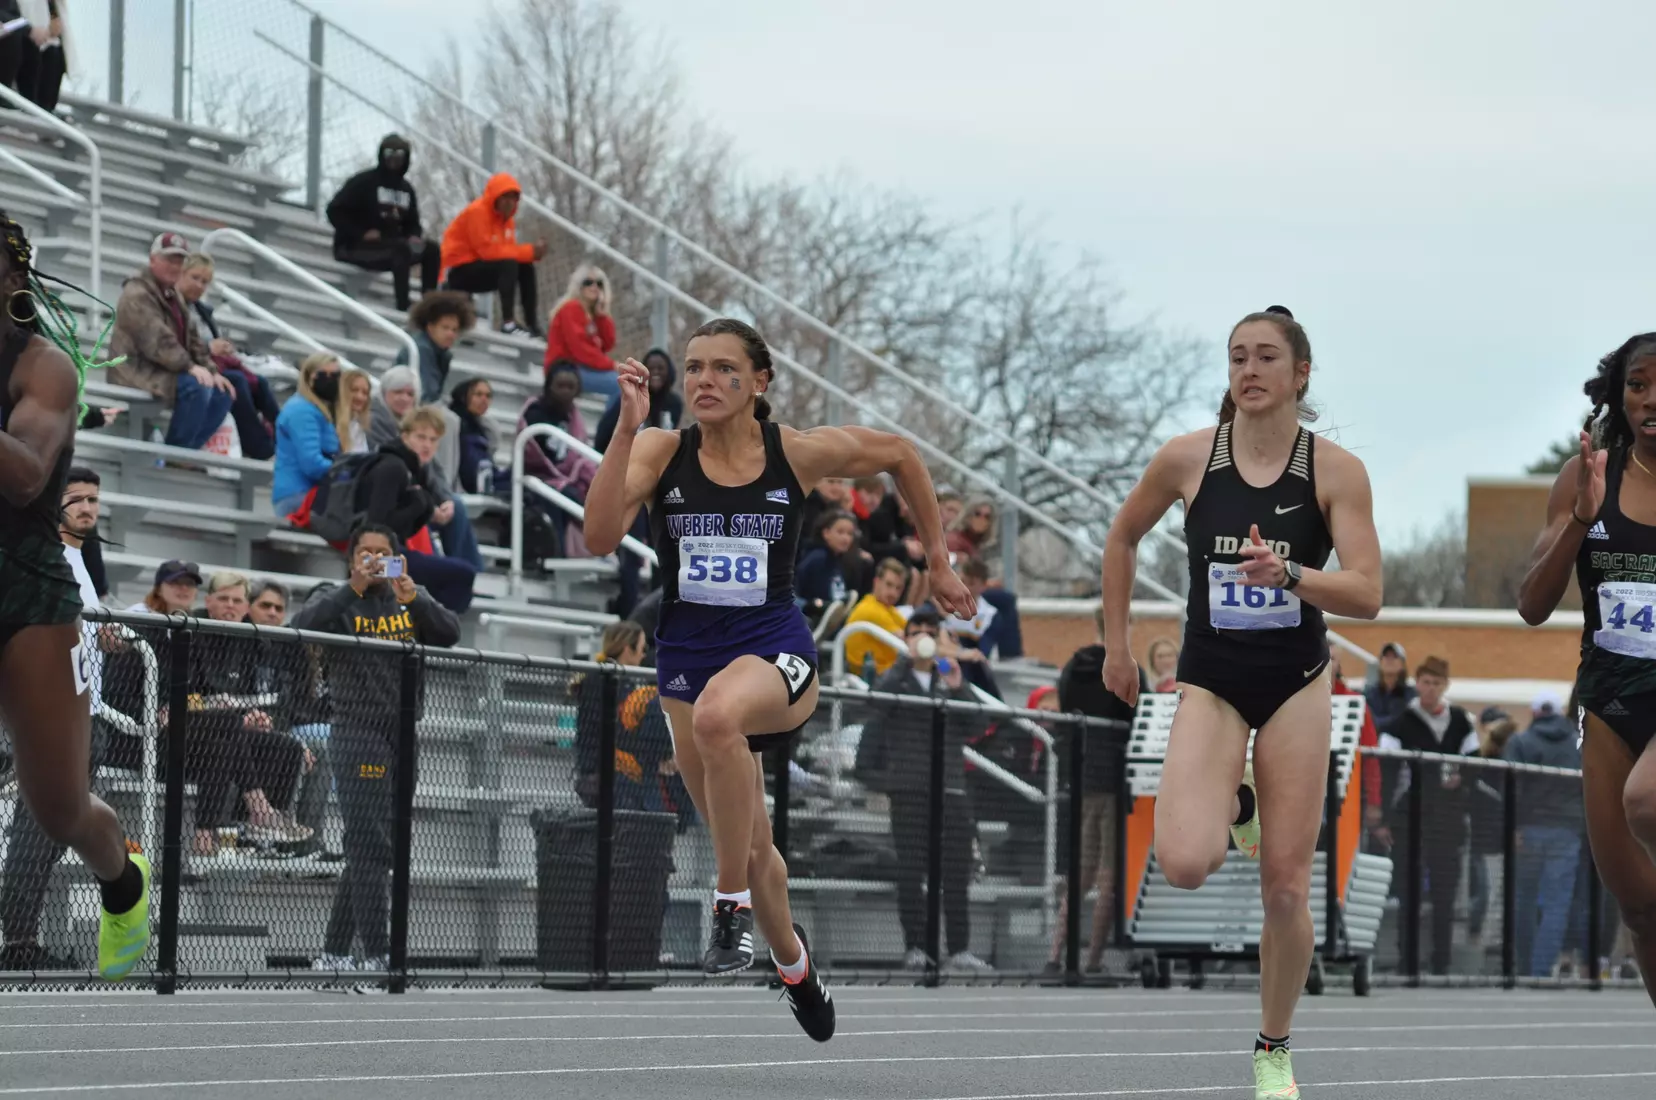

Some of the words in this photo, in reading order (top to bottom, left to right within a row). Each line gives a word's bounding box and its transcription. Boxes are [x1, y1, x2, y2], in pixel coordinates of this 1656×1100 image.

[666, 513, 726, 539] WEBER
[730, 513, 784, 540] STATE
[1587, 532, 1610, 541] adidas
[687, 555, 758, 583] 538
[1221, 581, 1289, 608] 161
[784, 655, 805, 682] 5
[666, 683, 691, 692] adidas
